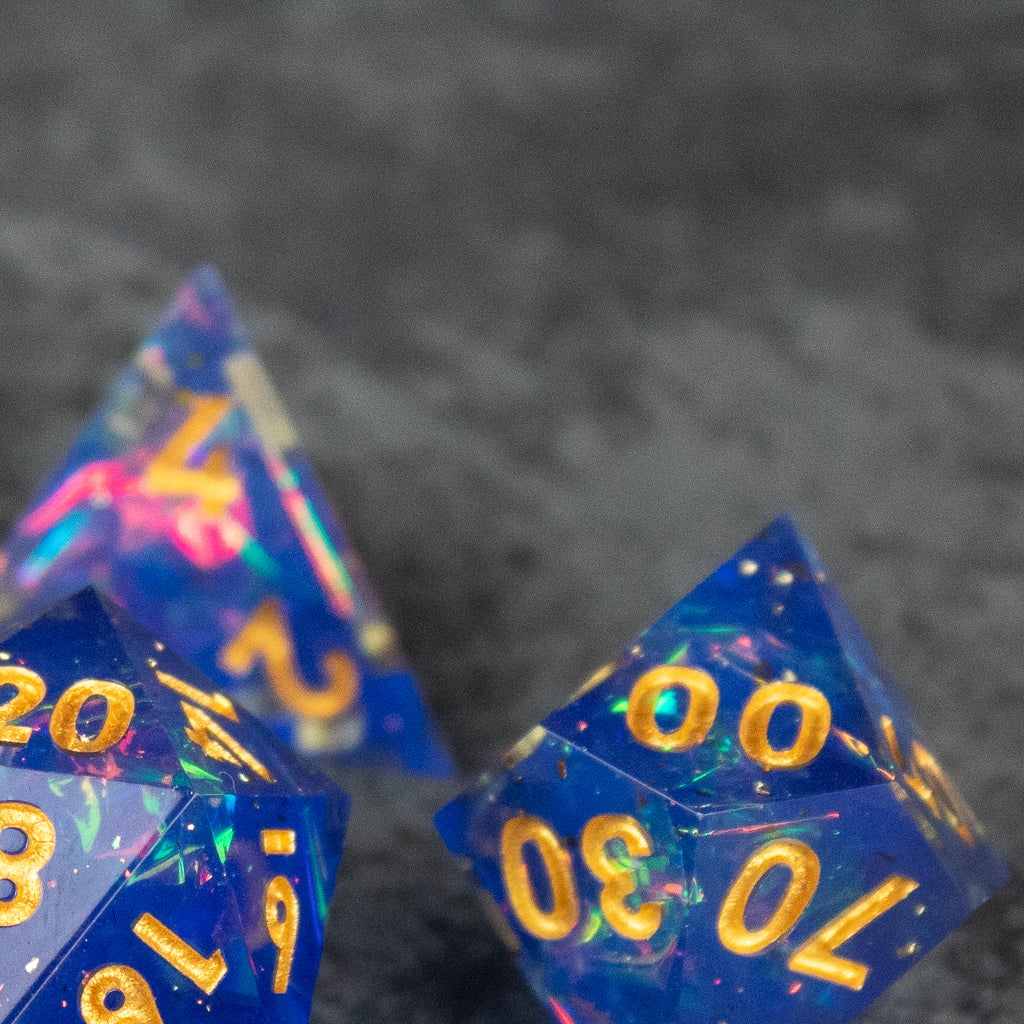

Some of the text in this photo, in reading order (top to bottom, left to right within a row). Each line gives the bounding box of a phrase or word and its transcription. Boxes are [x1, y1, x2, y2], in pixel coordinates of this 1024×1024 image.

[626, 665, 831, 770] 00
[501, 813, 663, 940] 30
[717, 838, 919, 990] 70
